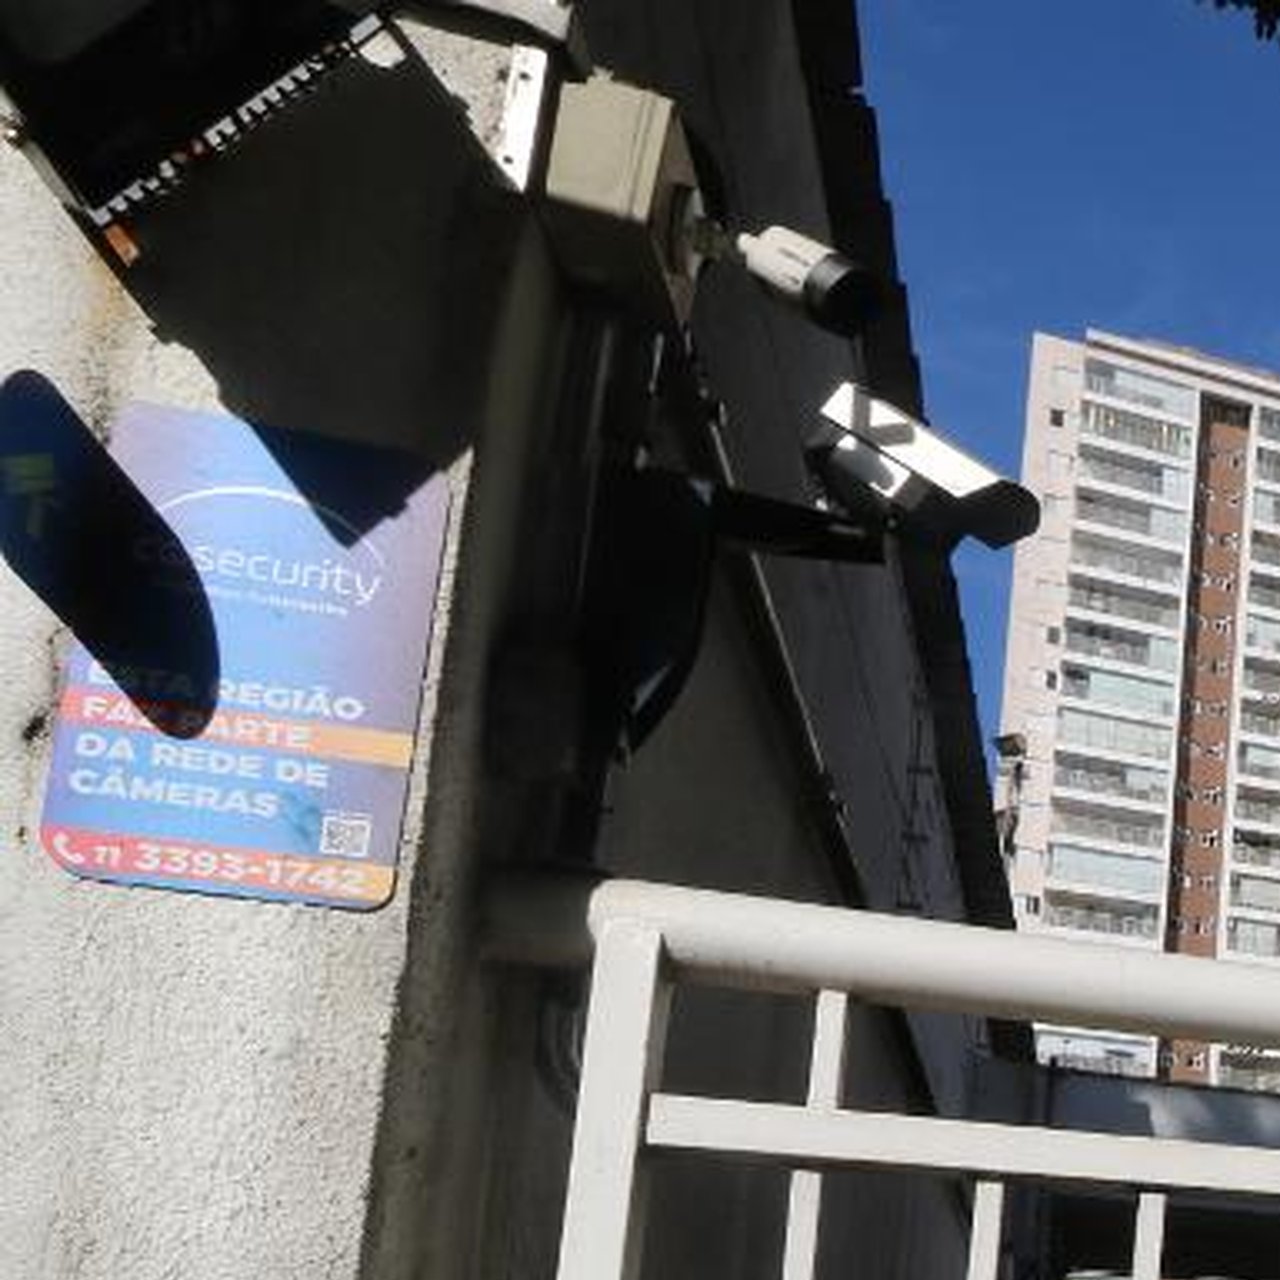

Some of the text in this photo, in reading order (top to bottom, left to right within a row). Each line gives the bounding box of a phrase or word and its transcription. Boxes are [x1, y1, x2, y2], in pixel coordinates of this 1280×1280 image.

[74, 732, 329, 788] DA REDE DE
